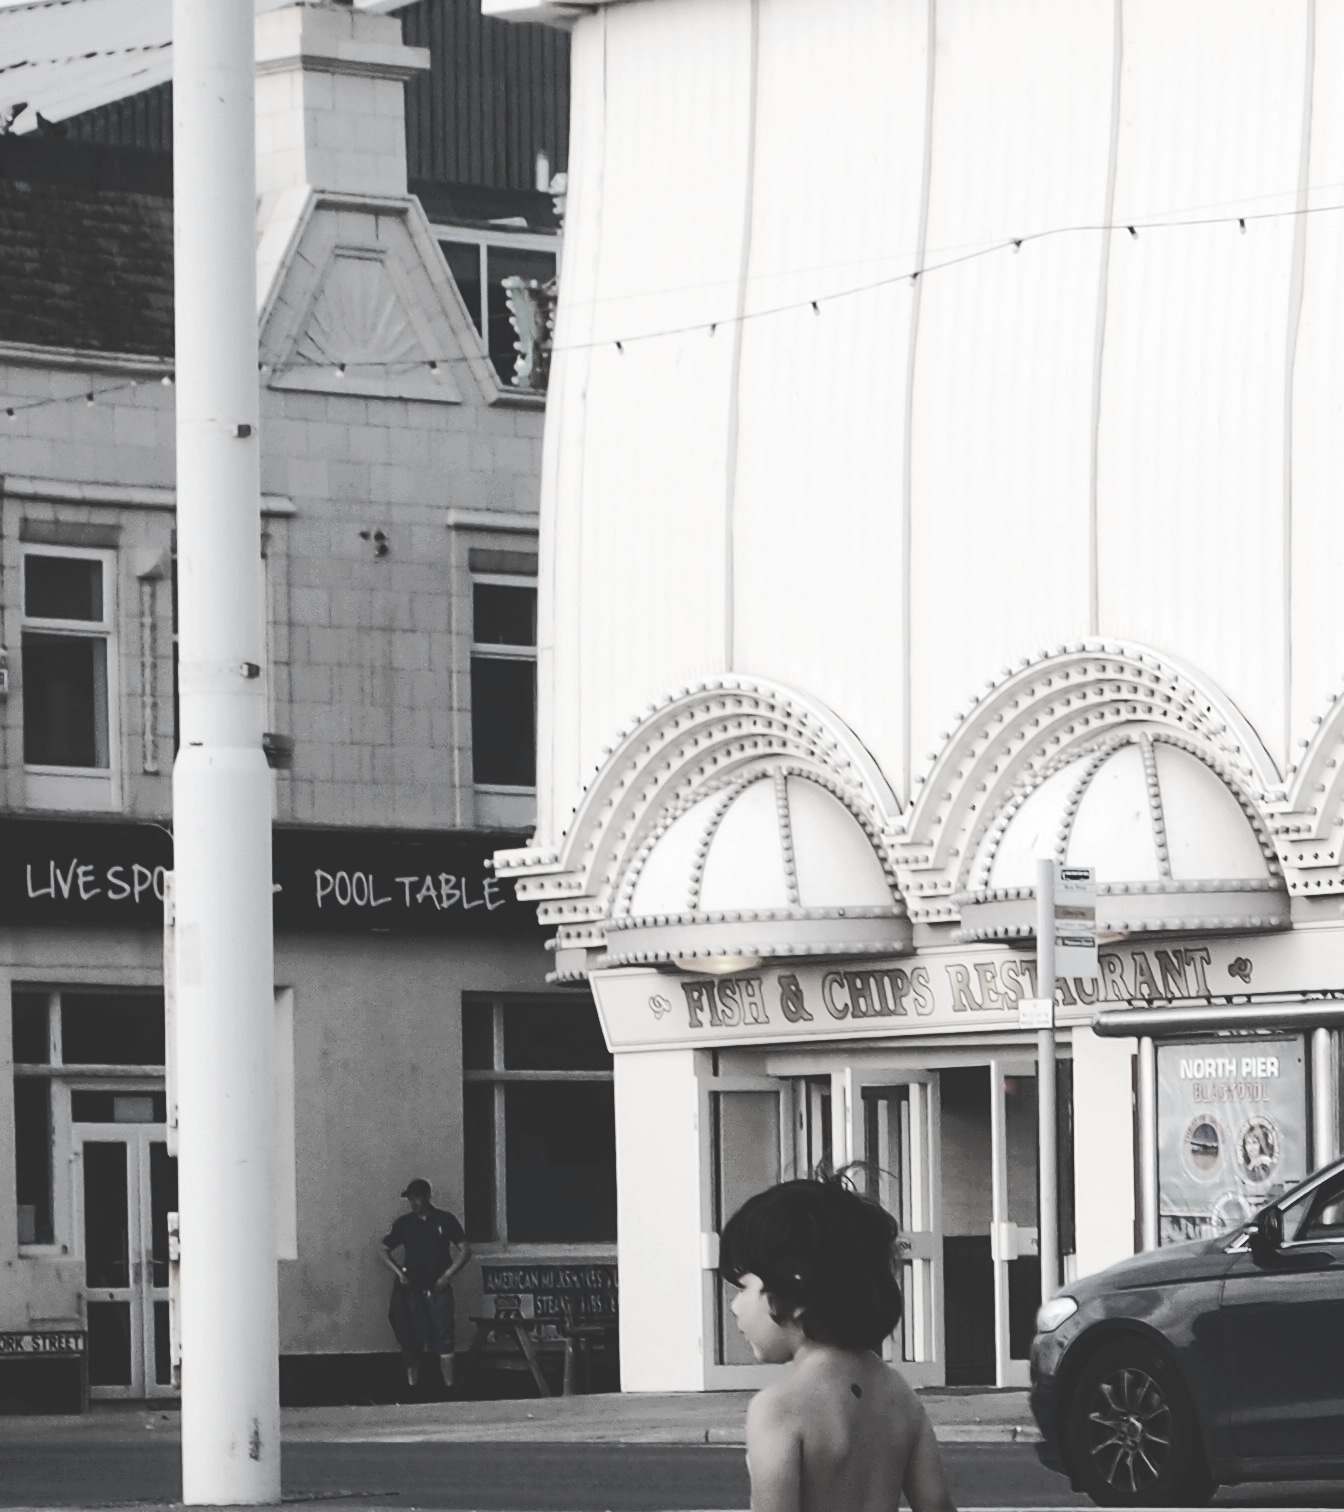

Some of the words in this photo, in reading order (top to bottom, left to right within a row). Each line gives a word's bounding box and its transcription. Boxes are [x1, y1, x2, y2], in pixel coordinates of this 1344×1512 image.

[26, 858, 101, 901] LIVE
[107, 864, 167, 903] SPO
[315, 868, 392, 908] POOL
[396, 873, 505, 910] TABLE
[681, 976, 770, 1028] FISH
[778, 974, 814, 1023] &
[821, 967, 936, 1021] CHIPS
[1180, 1057, 1237, 1079] NORTH
[1241, 1056, 1279, 1078] PIER
[1193, 1081, 1270, 1102] BLACKPOOL
[33, 1334, 84, 1351] STREET
